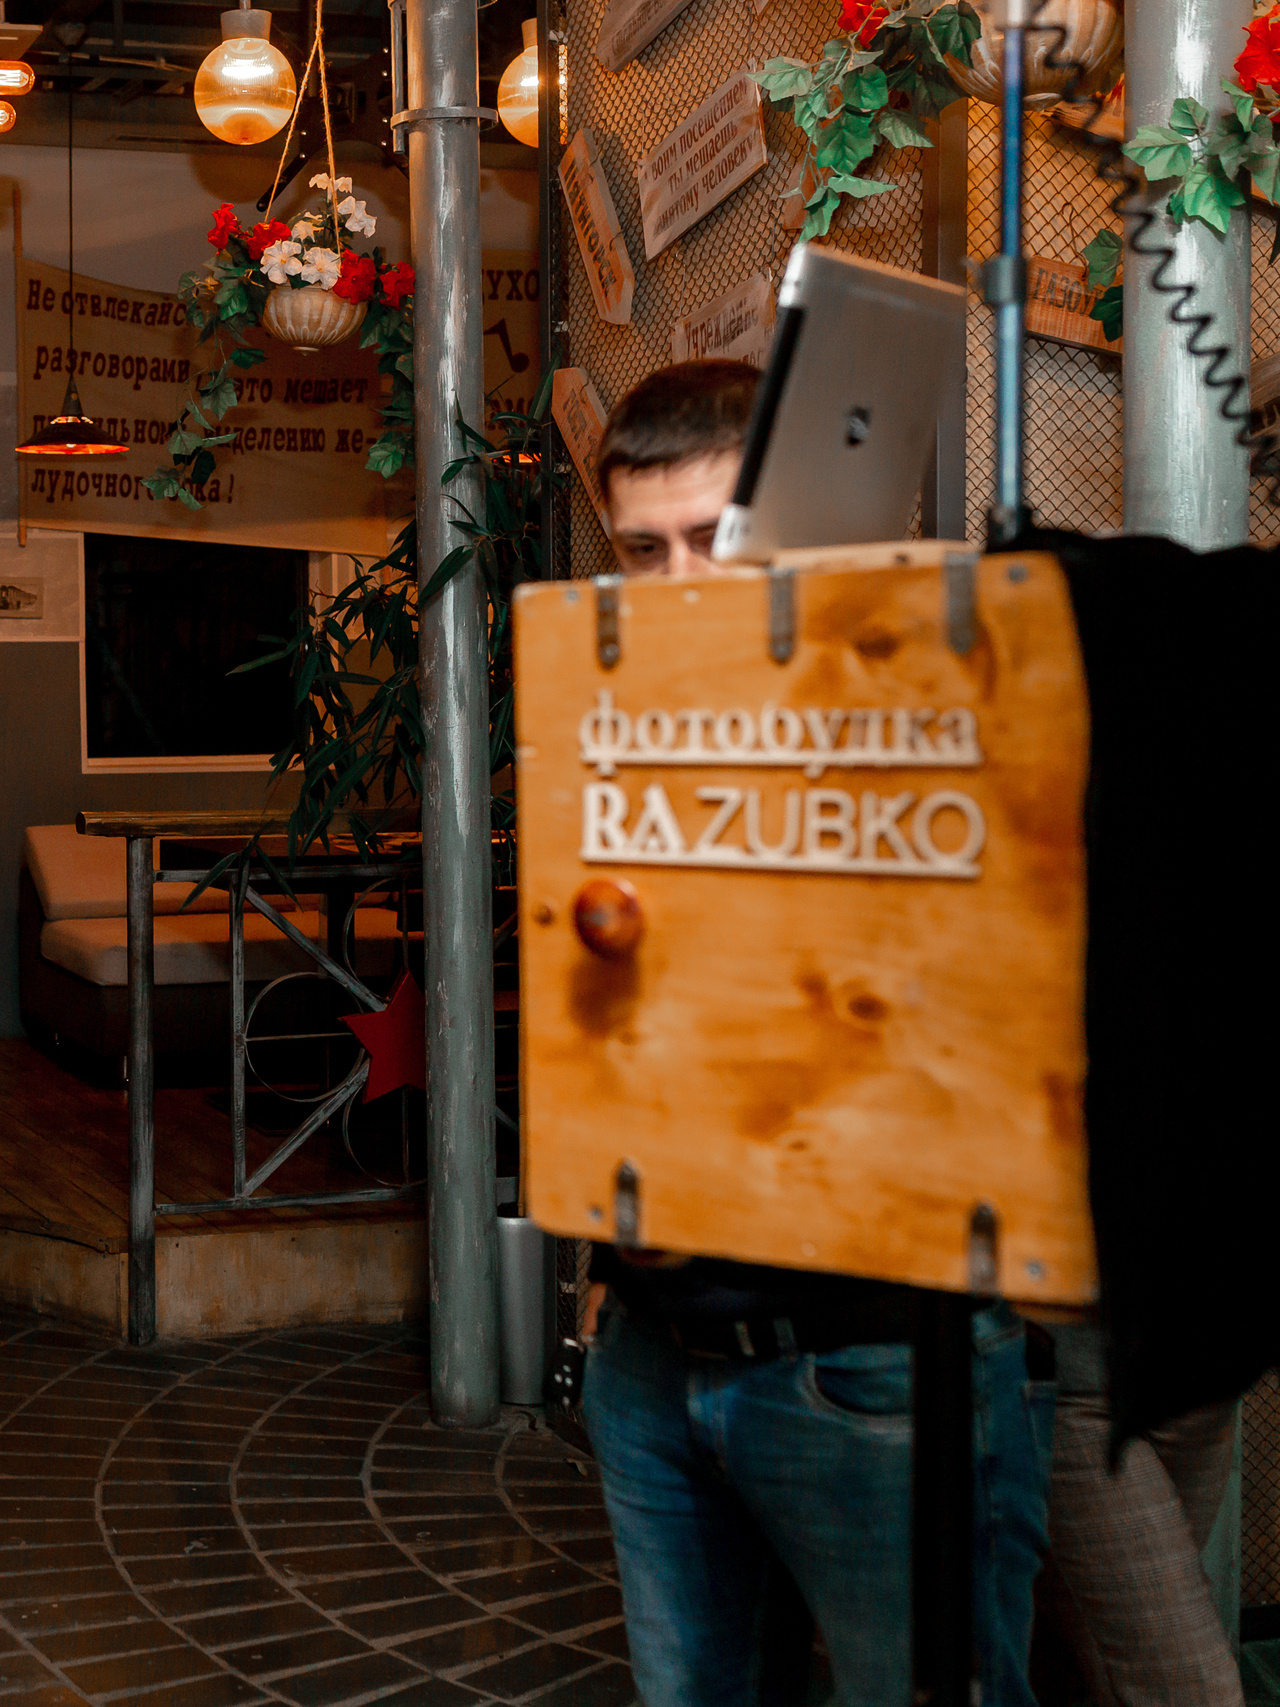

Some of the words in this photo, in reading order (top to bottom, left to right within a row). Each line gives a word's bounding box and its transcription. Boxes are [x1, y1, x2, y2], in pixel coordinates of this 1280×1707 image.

[679, 77, 747, 154] посещением
[668, 167, 683, 195] ты
[685, 121, 738, 178] мешаешь
[702, 130, 757, 193] человеку
[27, 279, 55, 311] Не
[61, 291, 192, 327] отвлекайс
[482, 269, 539, 304] УХО
[283, 377, 369, 404] мешает
